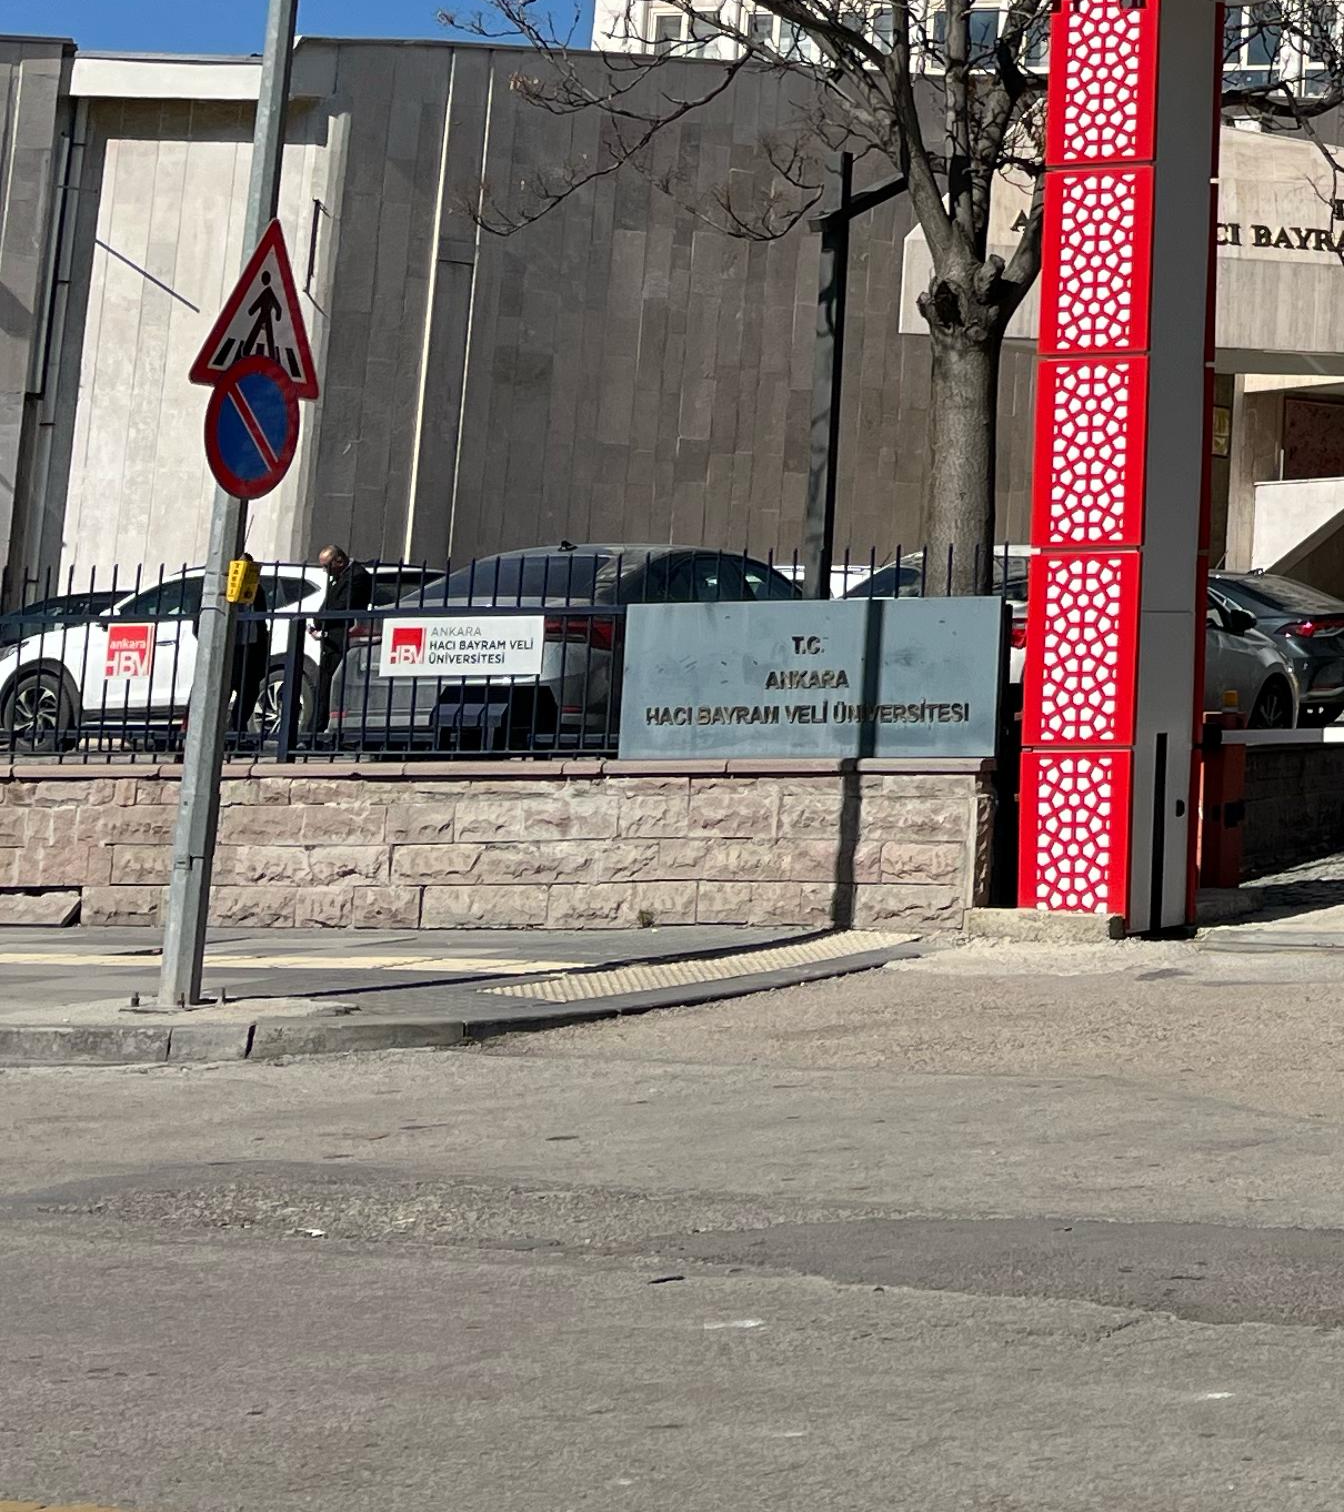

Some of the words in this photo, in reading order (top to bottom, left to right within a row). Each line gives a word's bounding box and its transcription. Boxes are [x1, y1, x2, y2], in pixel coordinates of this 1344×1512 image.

[430, 626, 482, 637] ANKARA
[429, 640, 456, 651] HACI
[459, 640, 506, 650] BAYRAM
[509, 637, 534, 650] VELİ
[791, 635, 826, 655] T.C.
[428, 651, 505, 665] ÜNİVERSİTESİ
[764, 669, 850, 690] ANKARA
[646, 705, 693, 726] HACI
[697, 704, 780, 726] BAYRAM
[785, 699, 829, 724] VELİ
